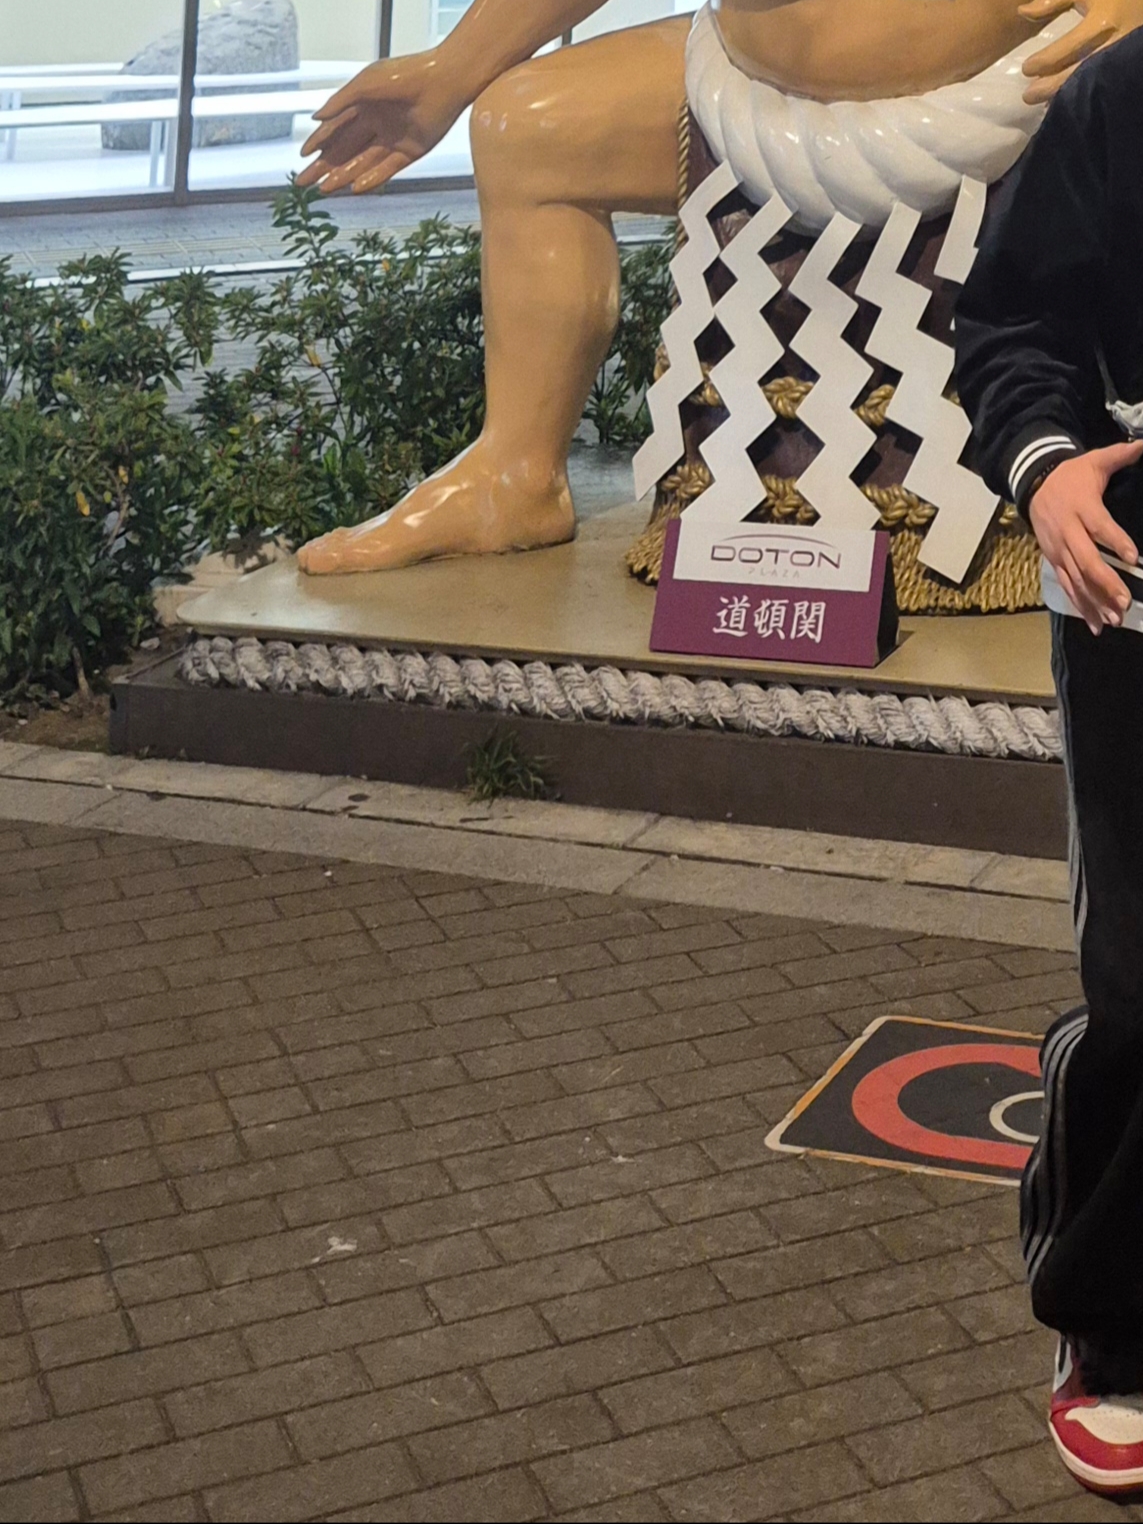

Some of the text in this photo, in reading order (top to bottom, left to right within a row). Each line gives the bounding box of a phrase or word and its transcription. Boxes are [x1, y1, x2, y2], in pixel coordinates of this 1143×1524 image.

[711, 545, 842, 570] DOTON
[712, 594, 827, 644] 道頓関
